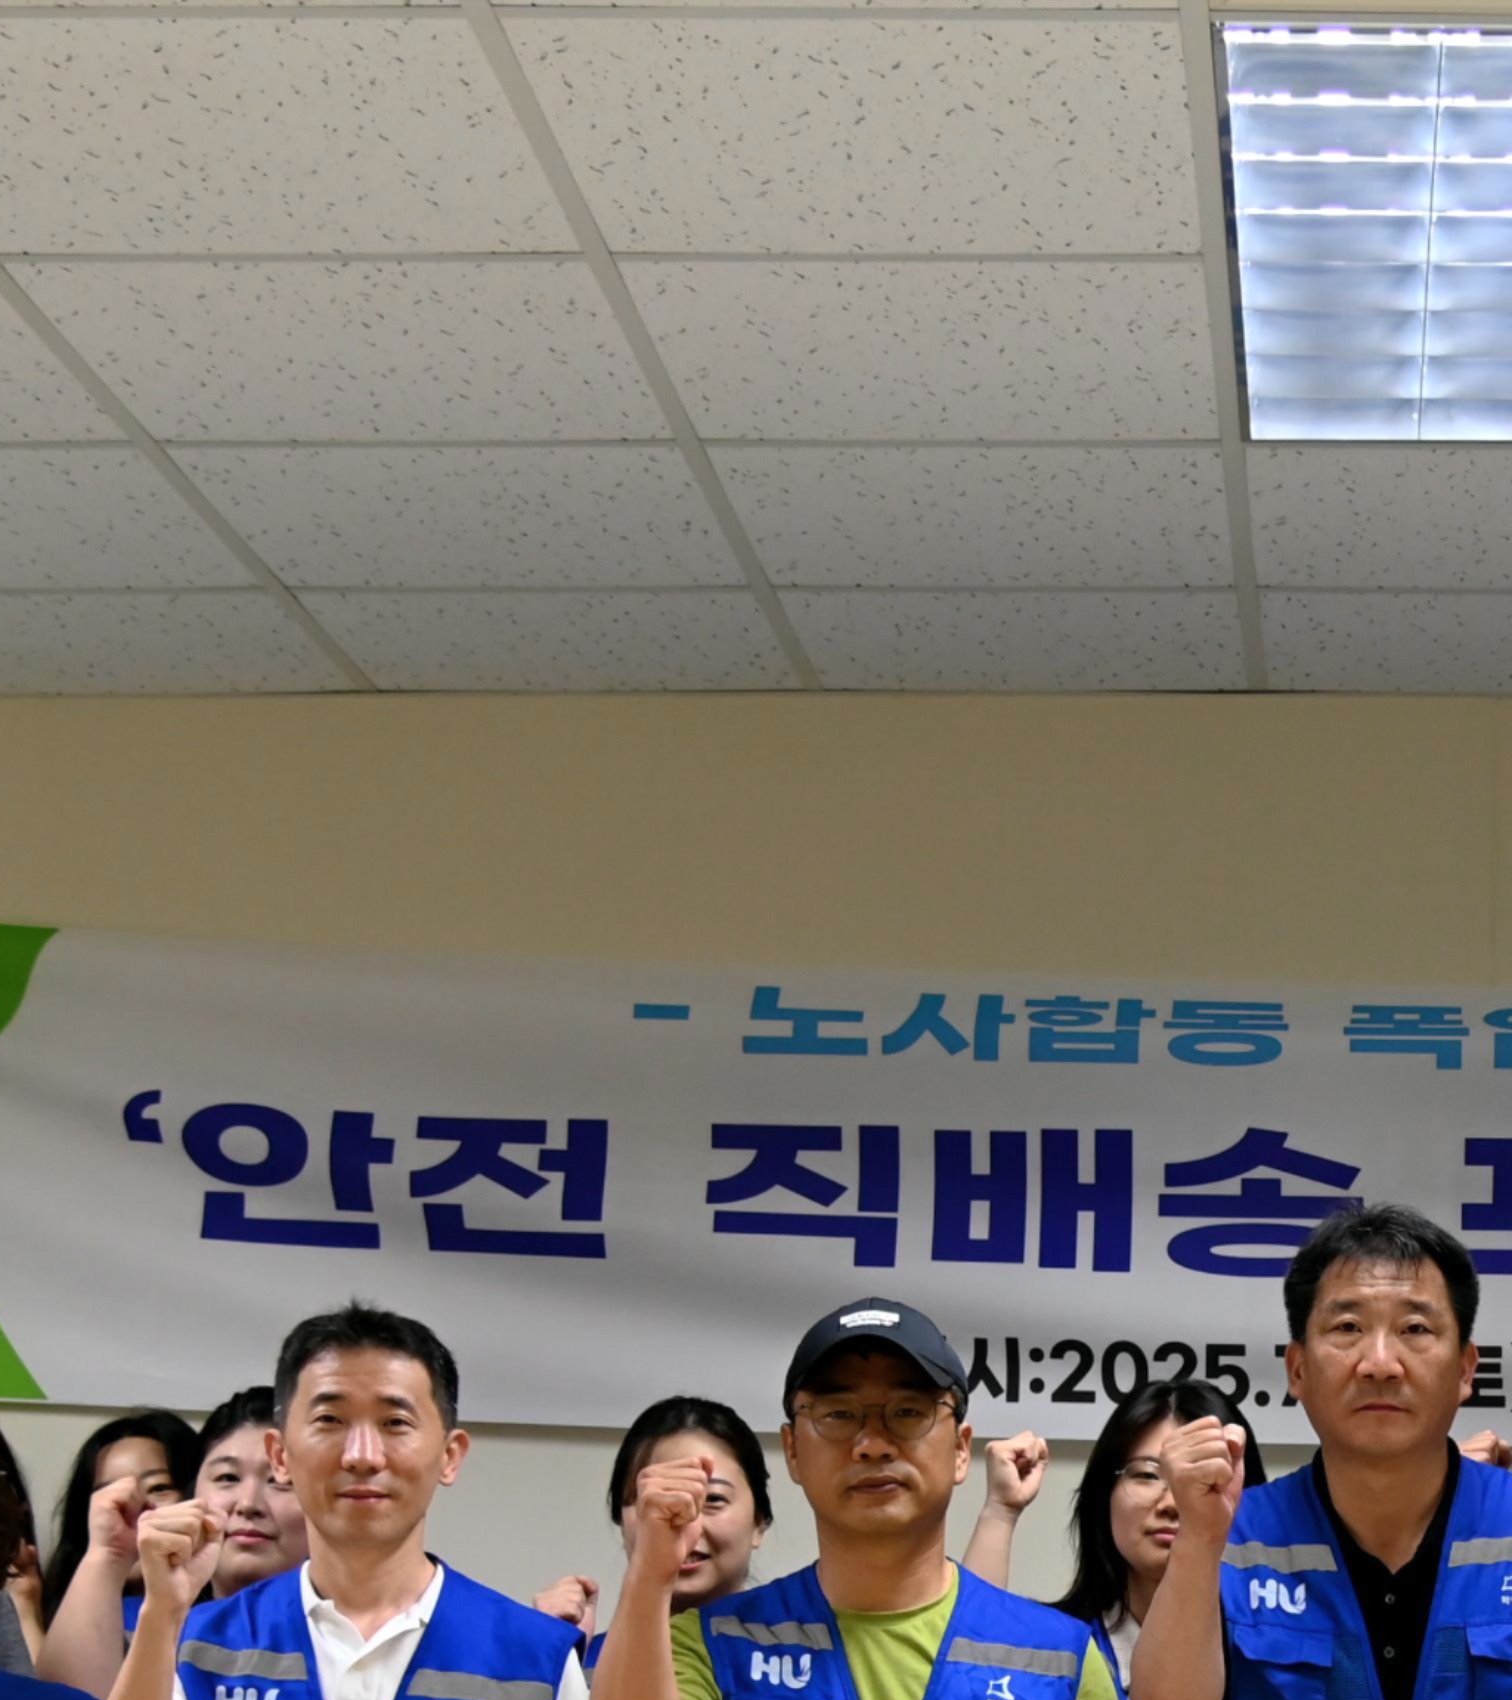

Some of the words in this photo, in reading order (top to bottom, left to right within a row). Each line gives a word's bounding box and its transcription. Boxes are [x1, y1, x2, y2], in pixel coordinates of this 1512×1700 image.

[742, 985, 1289, 1067] 노사합동
[705, 1123, 1364, 1278] 직배송
[1249, 1578, 1306, 1614] HU
[750, 1651, 812, 1689] HU
